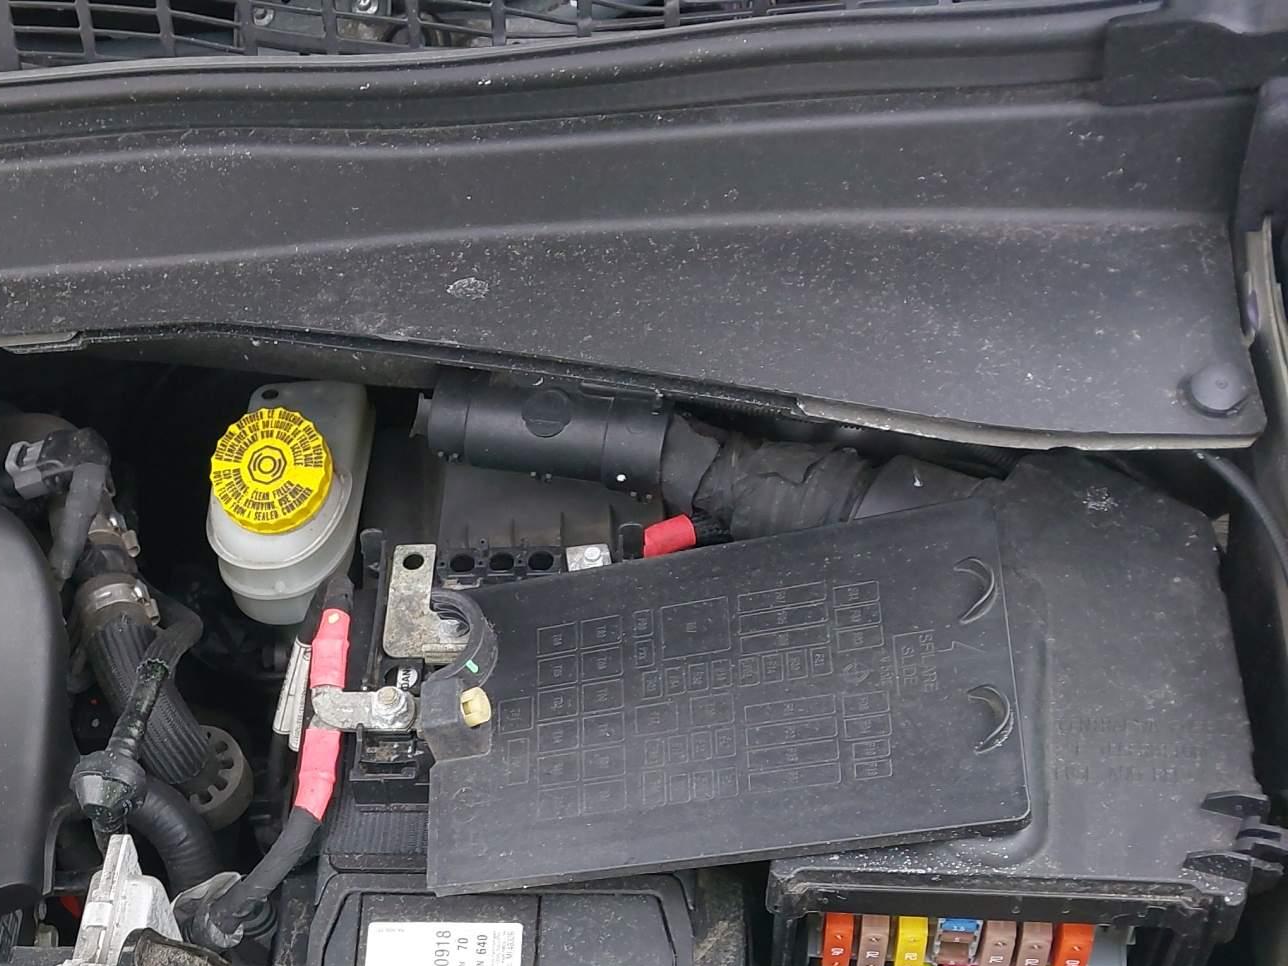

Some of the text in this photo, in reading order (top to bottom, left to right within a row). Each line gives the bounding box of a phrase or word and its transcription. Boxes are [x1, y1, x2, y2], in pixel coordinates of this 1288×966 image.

[252, 490, 270, 500] CLEAN
[254, 511, 278, 520] SEALED
[458, 937, 469, 951] 70
[476, 934, 488, 956] 640
